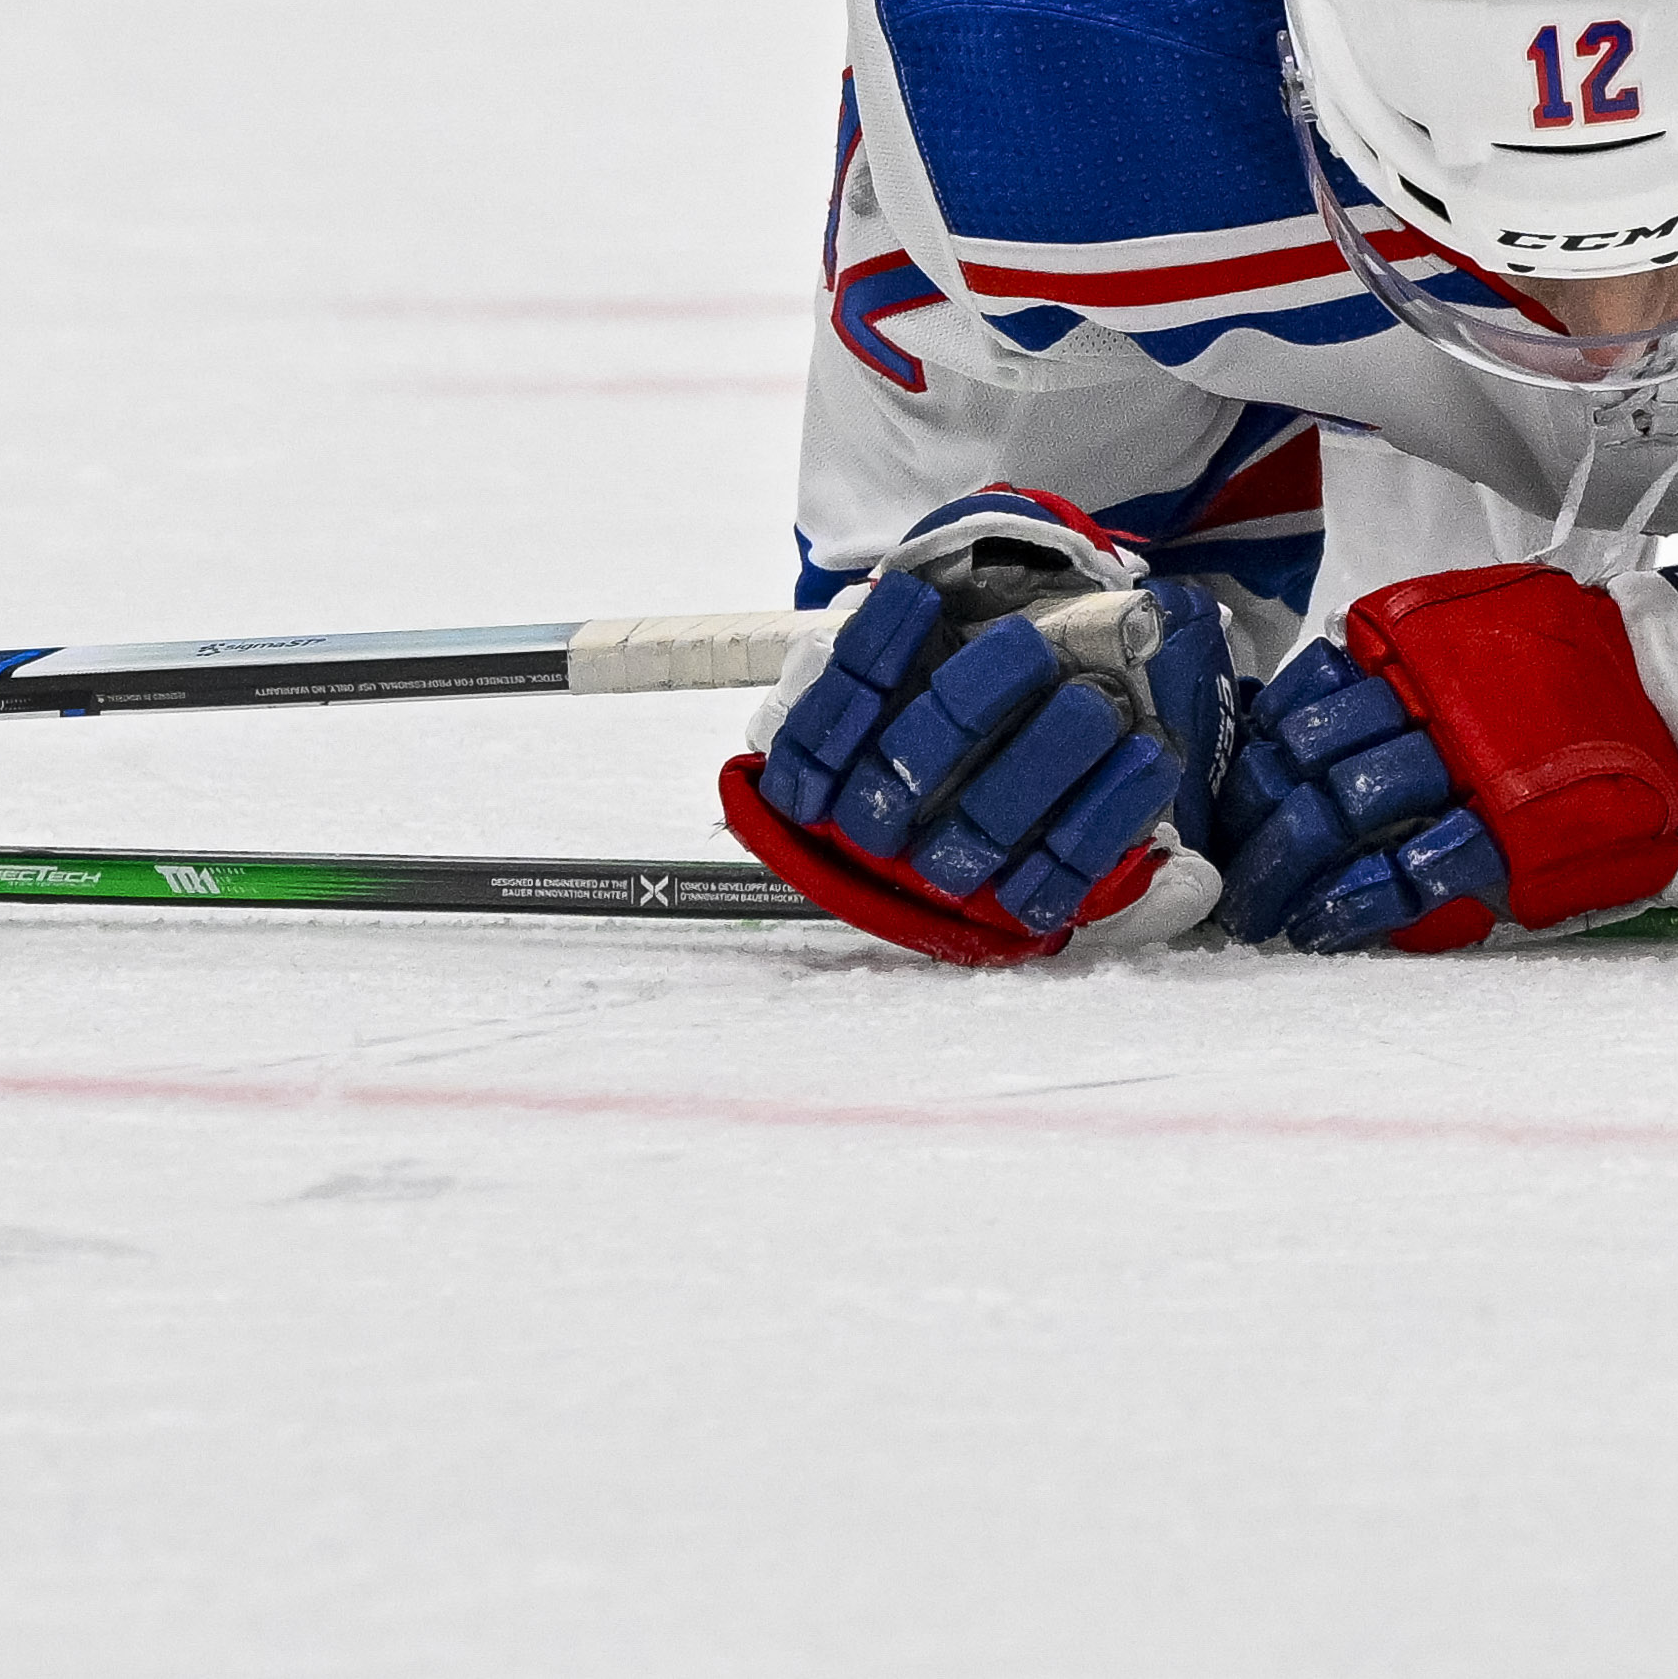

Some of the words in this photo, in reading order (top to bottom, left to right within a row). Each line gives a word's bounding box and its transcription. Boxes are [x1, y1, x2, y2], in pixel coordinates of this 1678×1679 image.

[1526, 19, 1642, 131] 12
[453, 677, 475, 688] FOR
[599, 879, 610, 889] AT
[611, 879, 628, 890] THE
[501, 888, 533, 898] BAUER
[592, 890, 628, 901] CENTER
